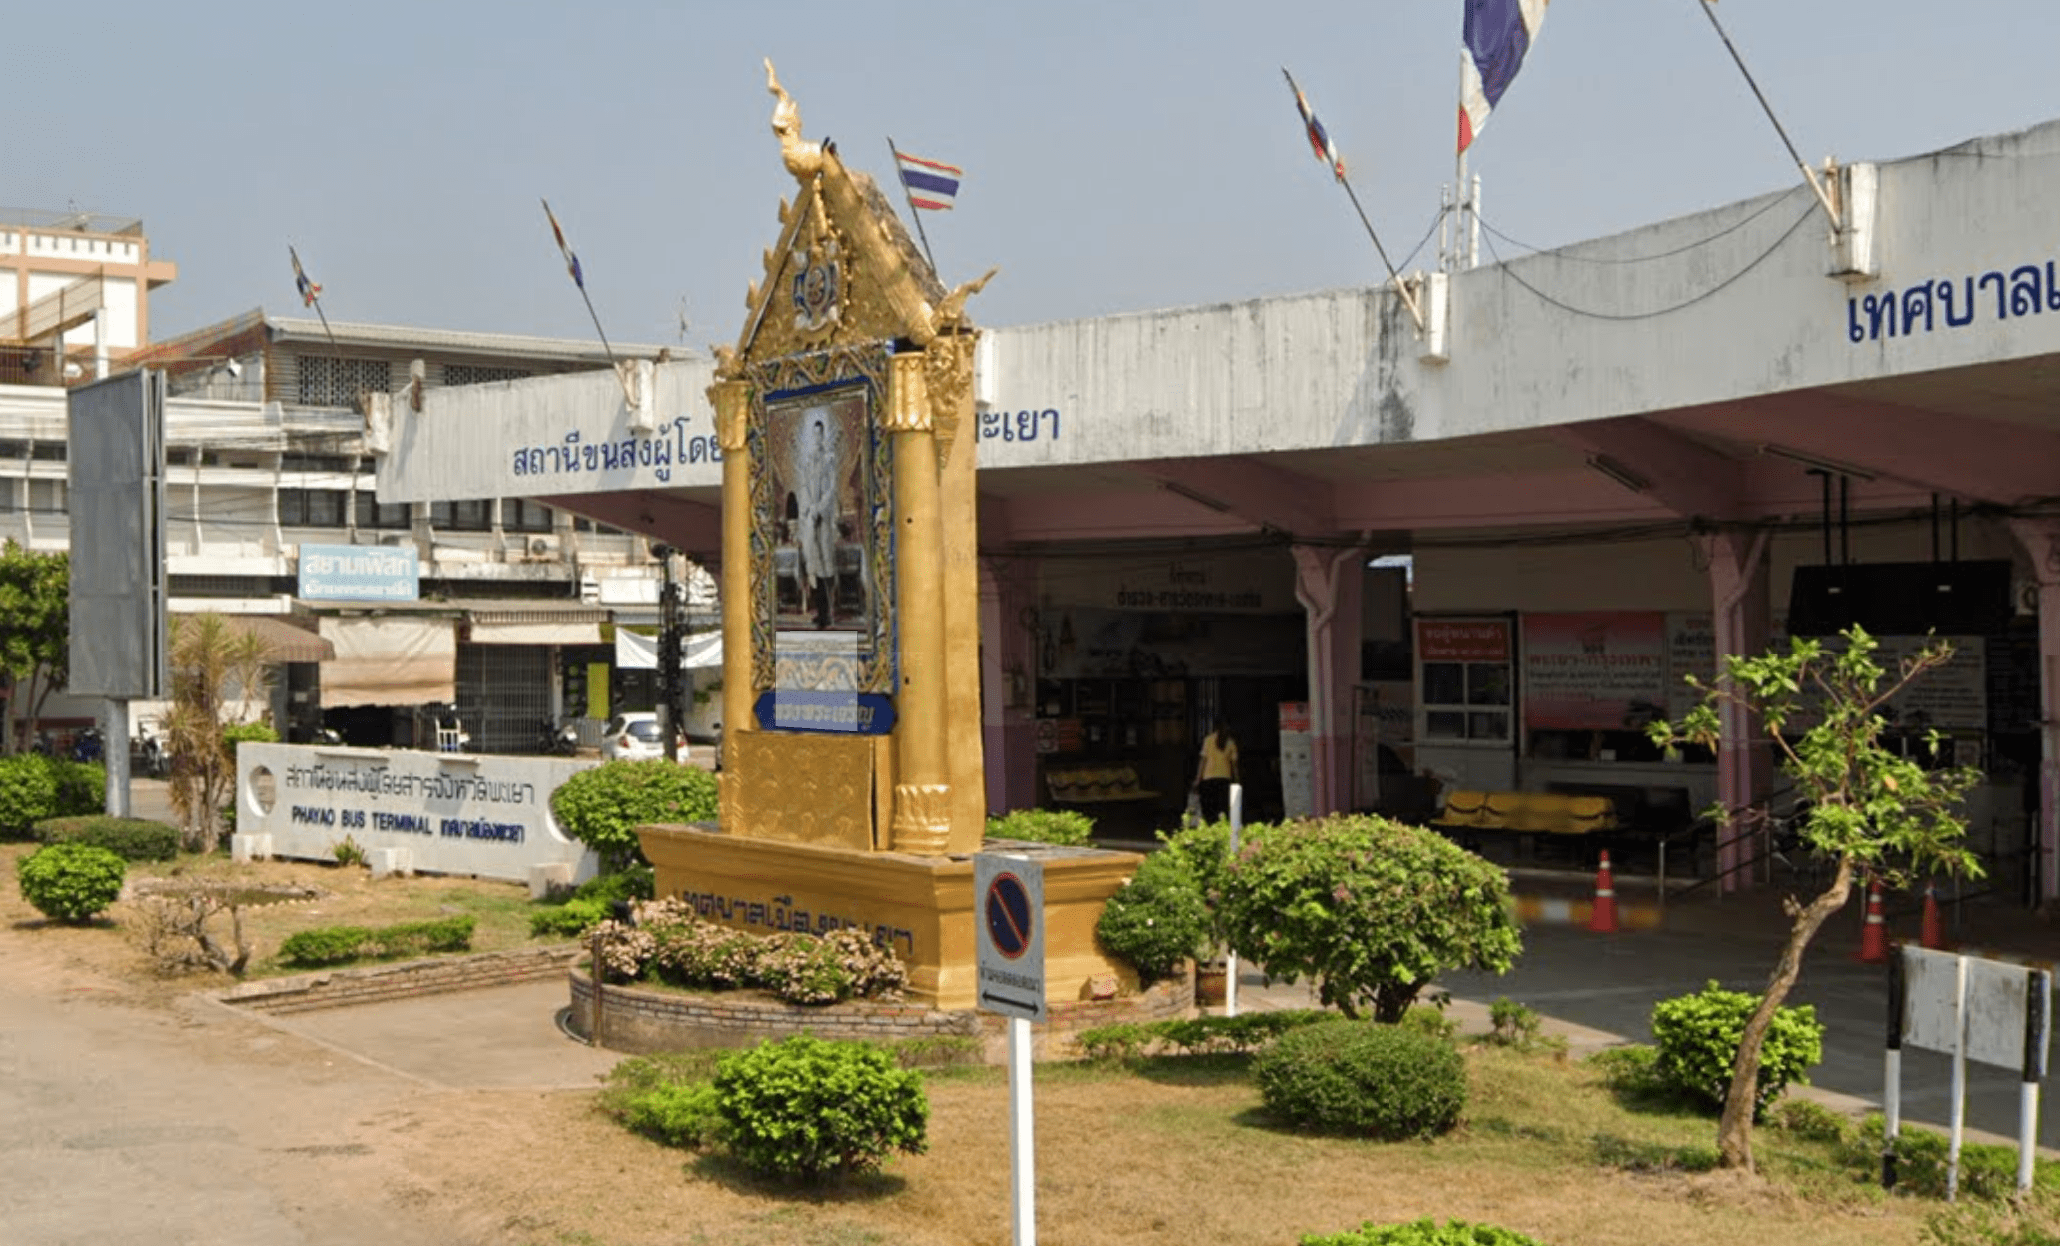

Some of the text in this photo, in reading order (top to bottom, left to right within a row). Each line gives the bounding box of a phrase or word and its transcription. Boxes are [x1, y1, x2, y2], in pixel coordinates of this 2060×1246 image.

[975, 408, 1059, 443] ะเยา
[291, 805, 336, 828] PHAYAO
[341, 809, 366, 829] BUS
[371, 811, 433, 836] TERMINAL
